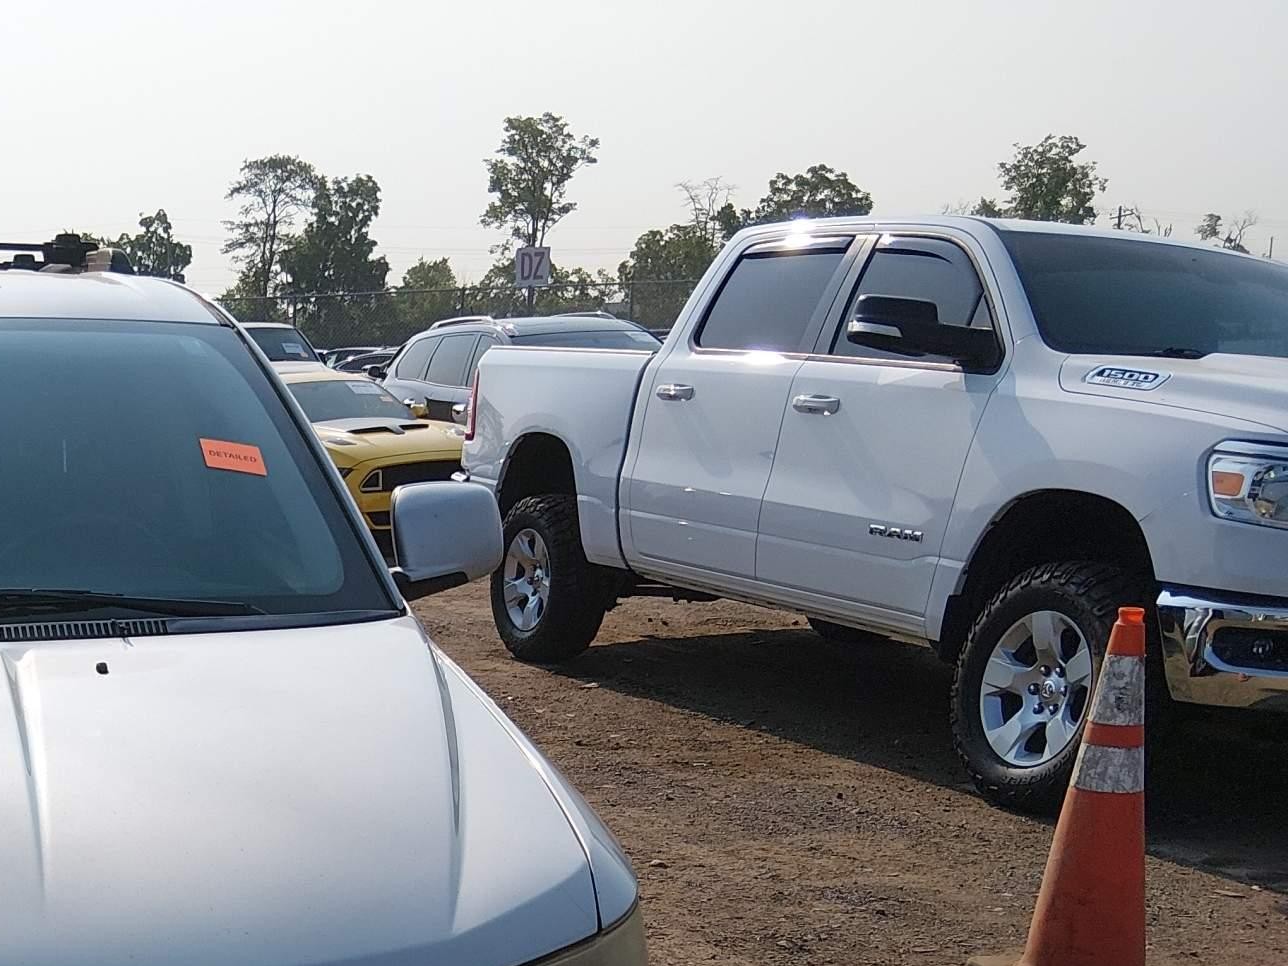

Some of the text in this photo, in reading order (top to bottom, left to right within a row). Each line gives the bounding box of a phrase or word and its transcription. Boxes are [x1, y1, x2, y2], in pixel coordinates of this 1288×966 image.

[521, 251, 545, 280] DZ
[1102, 369, 1157, 383] 1500
[208, 449, 257, 463] DETAILED
[869, 524, 924, 543] RAM
